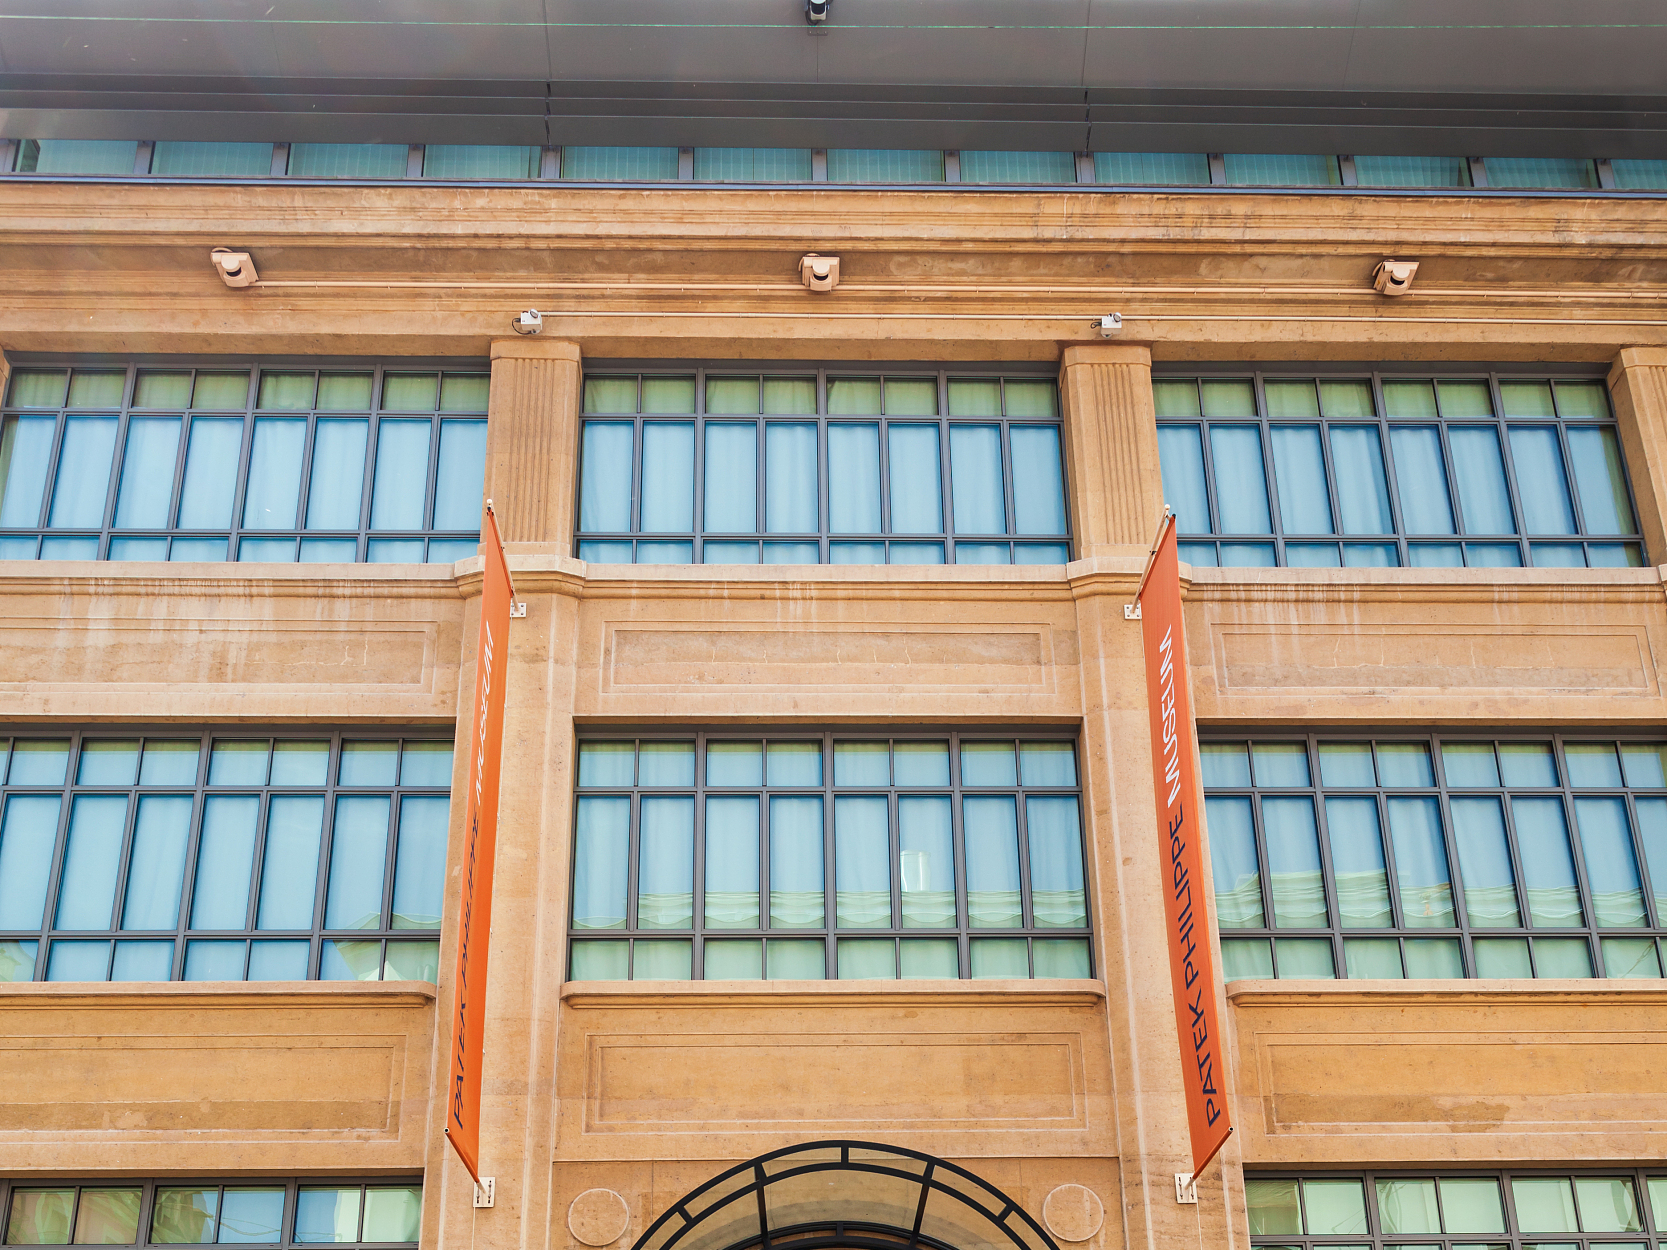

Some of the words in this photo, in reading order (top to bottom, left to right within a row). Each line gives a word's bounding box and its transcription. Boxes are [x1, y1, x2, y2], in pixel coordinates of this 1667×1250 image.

[1159, 624, 1181, 808] MUSEUM
[453, 988, 466, 1130] PATEK
[461, 802, 479, 990] PHILIPPE
[476, 620, 494, 806] MUSEUM
[1169, 801, 1199, 990] PHILIPPE
[1188, 987, 1221, 1128] PATEK
